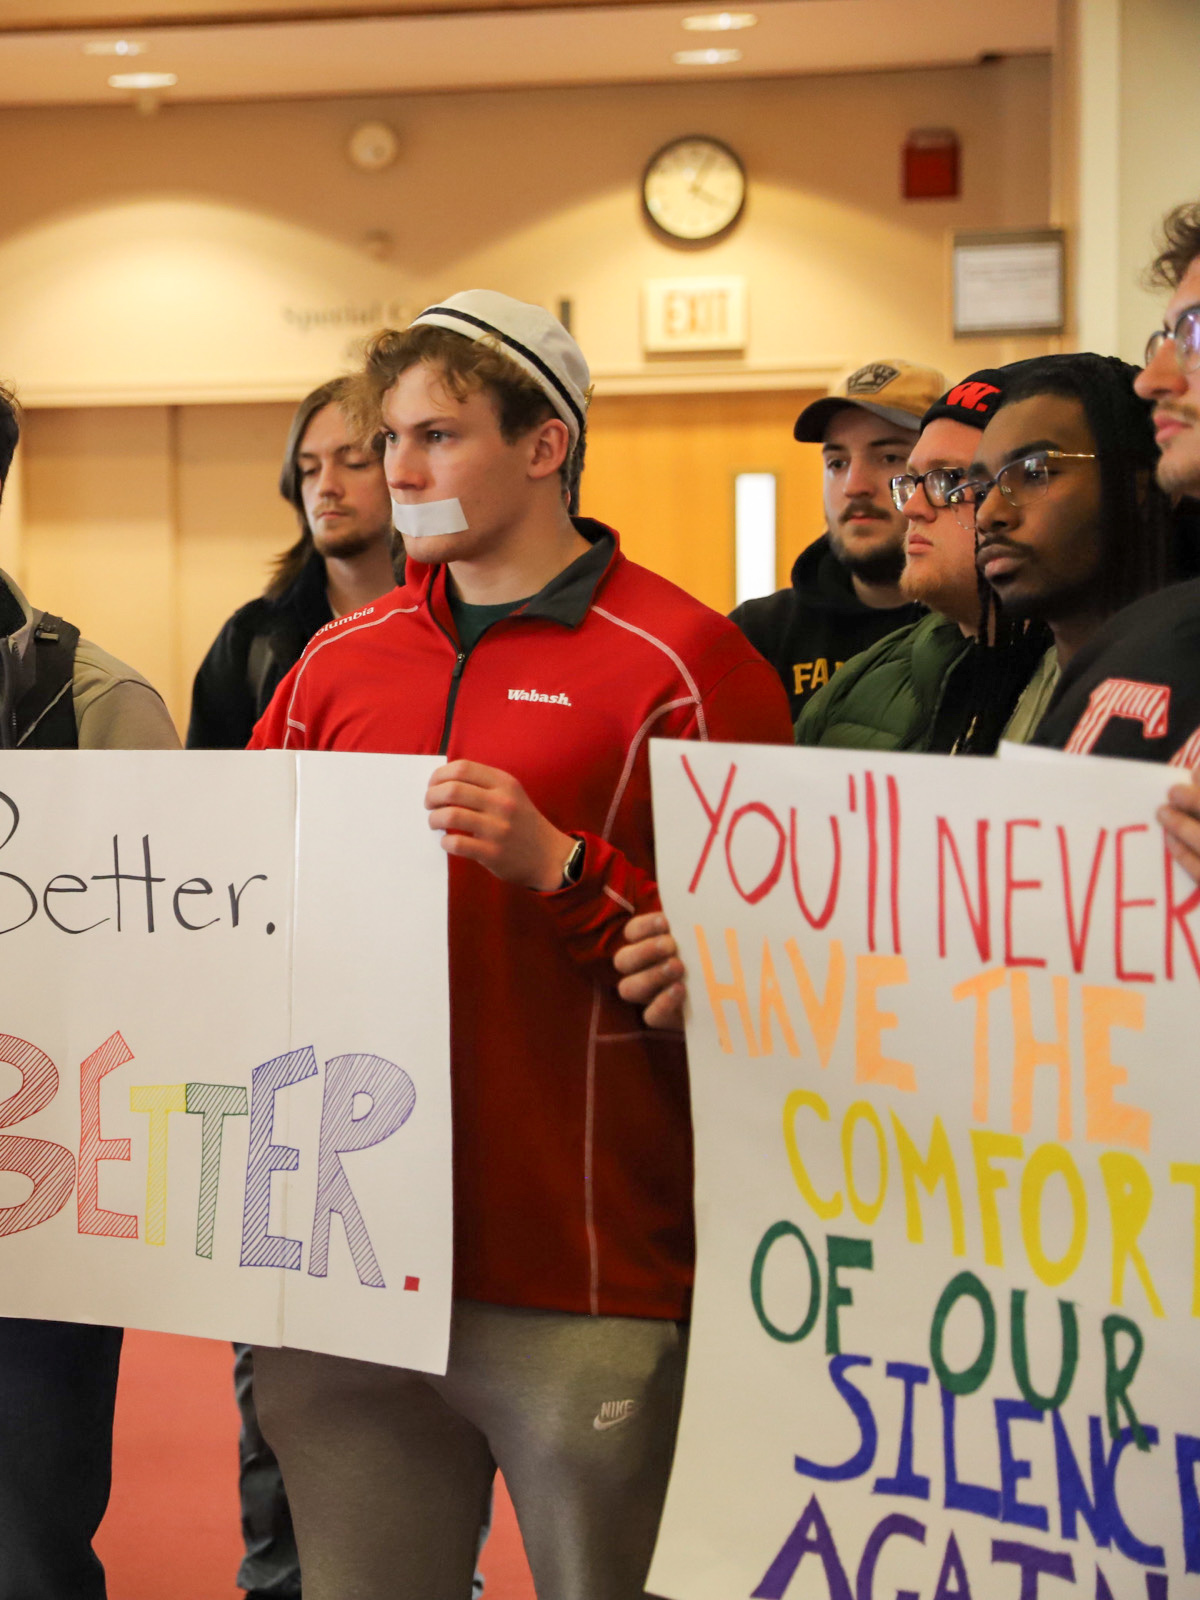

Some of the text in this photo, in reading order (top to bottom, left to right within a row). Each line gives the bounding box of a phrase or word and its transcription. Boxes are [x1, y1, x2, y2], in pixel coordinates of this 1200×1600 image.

[663, 288, 729, 339] EXIT
[303, 605, 376, 652] olumbia
[507, 688, 572, 707] Wabash.
[792, 657, 845, 695] FA
[693, 922, 1152, 1154] HAVE THE
[750, 1220, 1151, 1453] OF OUR
[600, 1399, 635, 1418] NIKE
